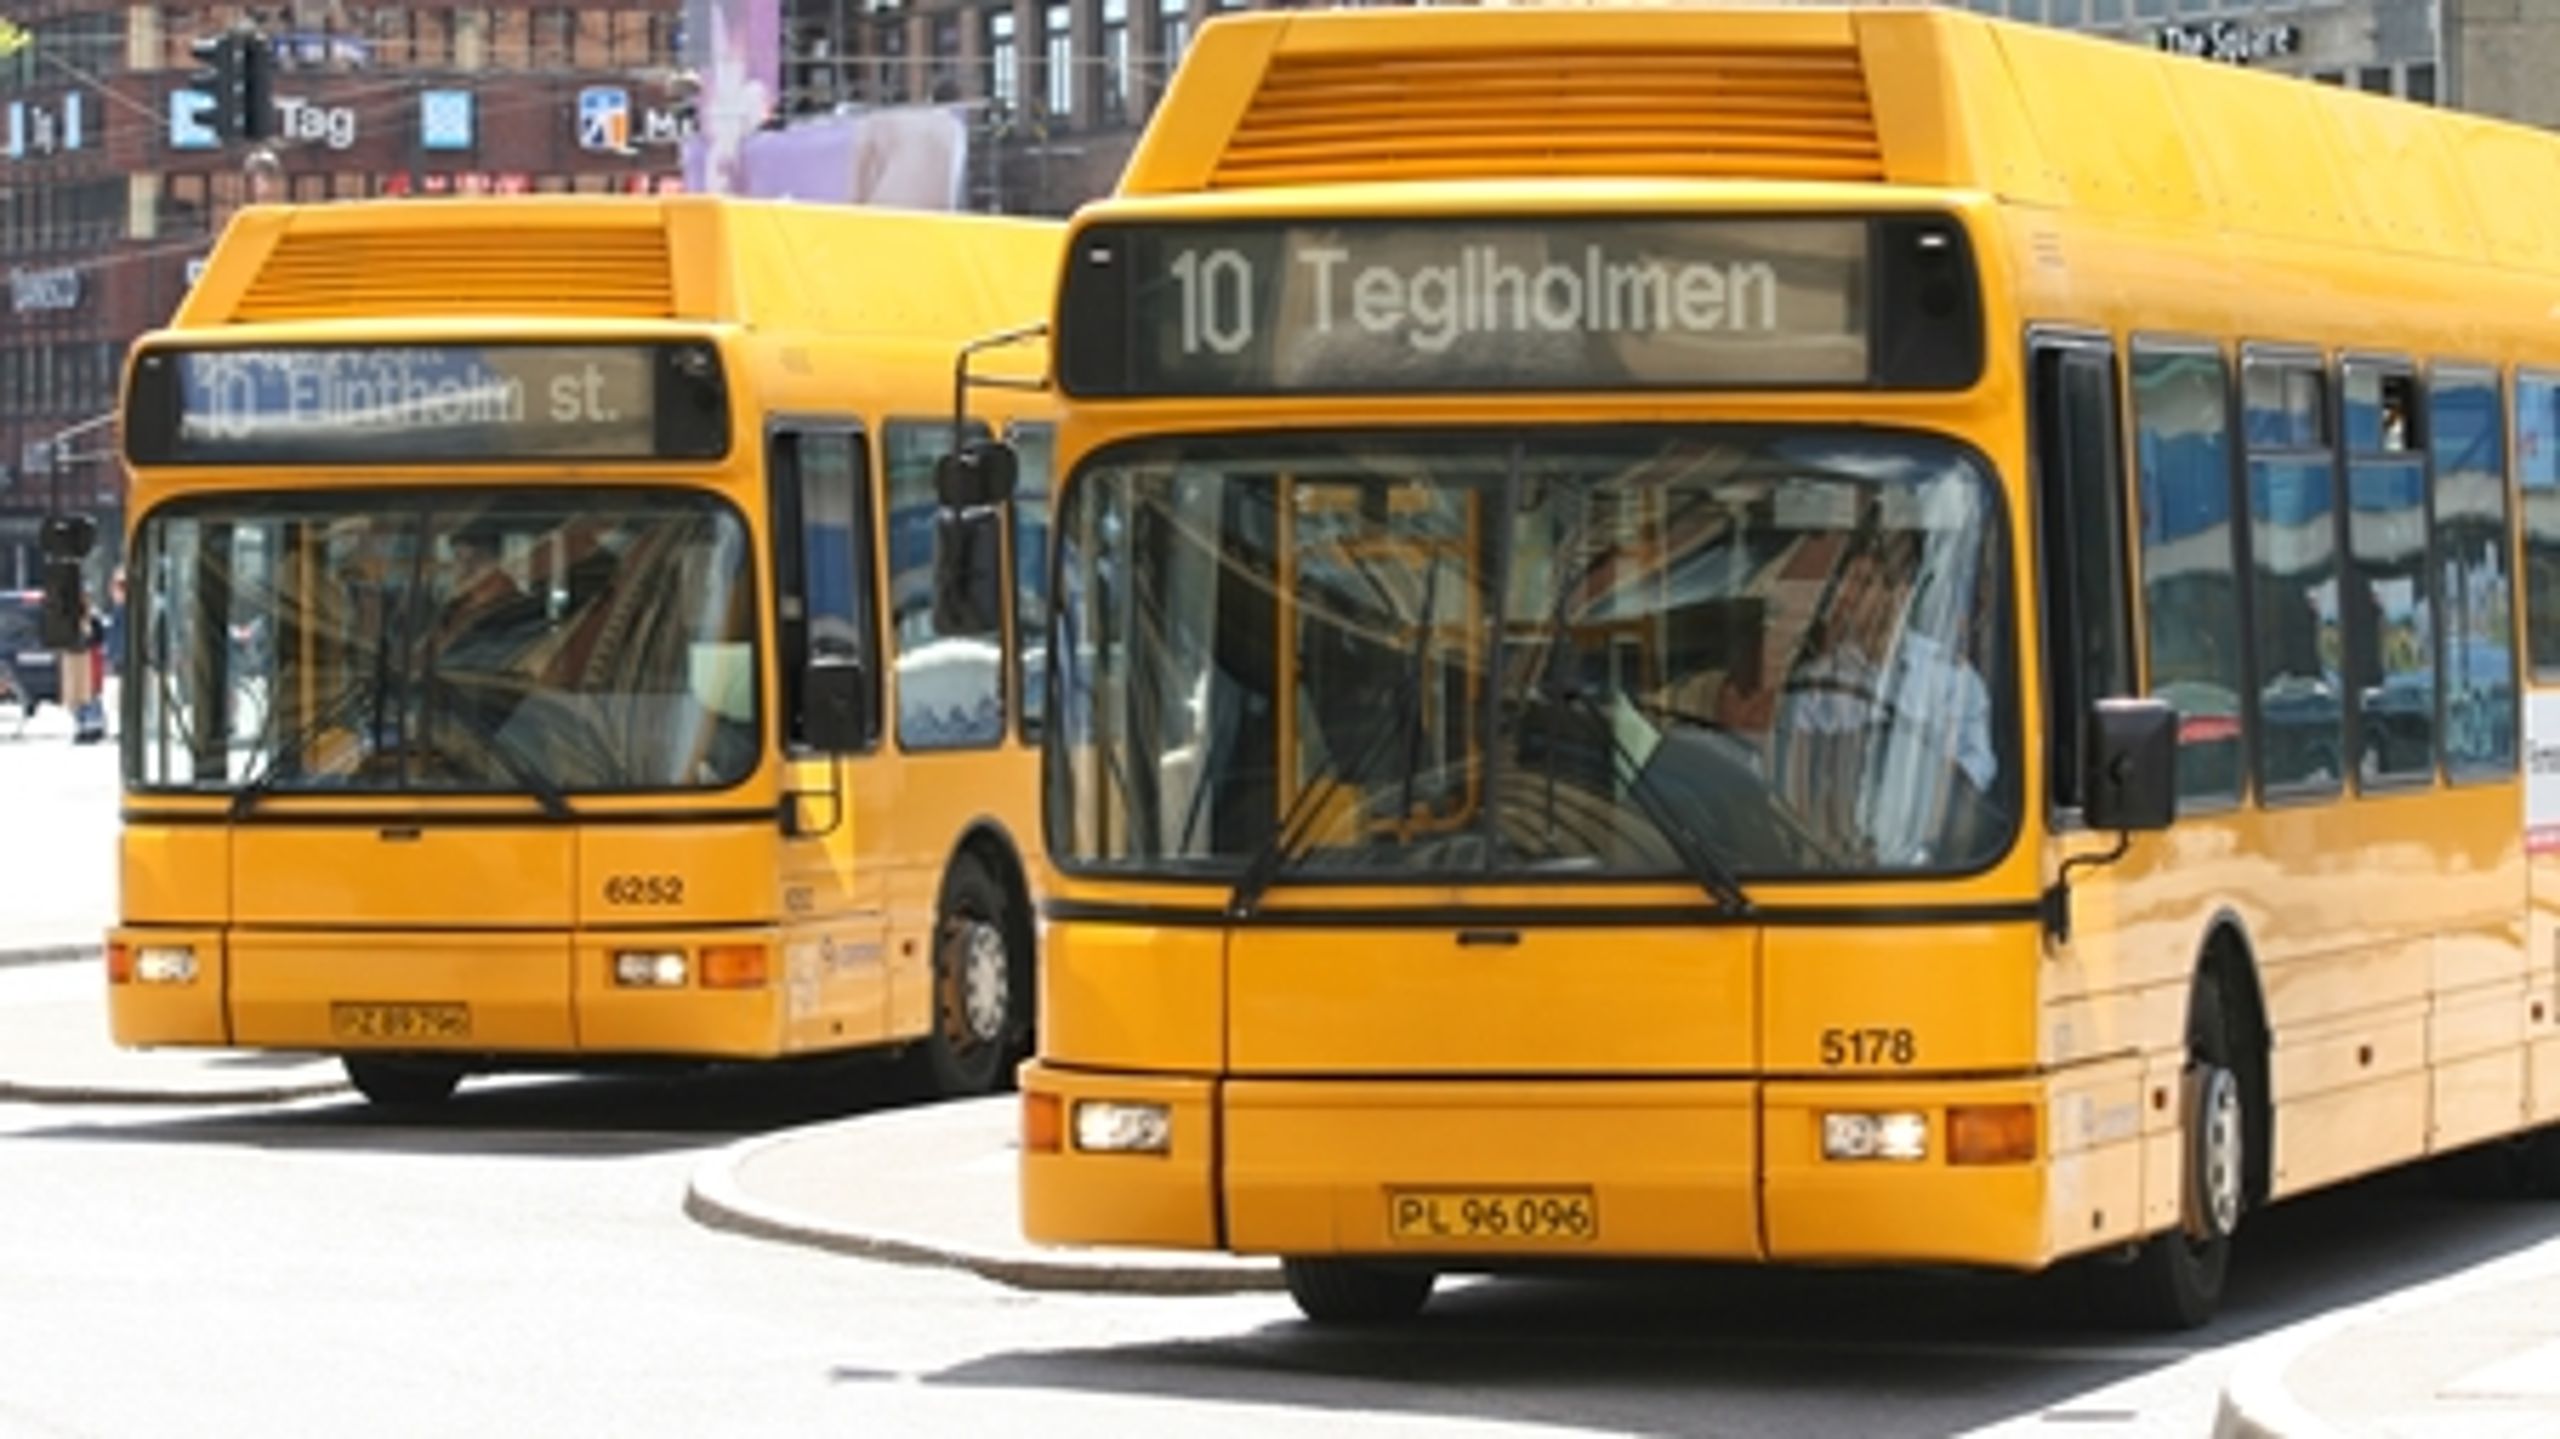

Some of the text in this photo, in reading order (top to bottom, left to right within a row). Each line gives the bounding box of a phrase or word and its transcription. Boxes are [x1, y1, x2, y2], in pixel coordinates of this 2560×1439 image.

[2165, 21, 2290, 63] The Square
[273, 96, 354, 148] Tag
[1170, 245, 1776, 353] 10 Teglholmen
[202, 363, 257, 439] 10
[551, 364, 619, 422] st.
[603, 875, 684, 905] 6252
[1821, 1029, 1916, 1065] 5178
[1399, 1200, 1589, 1234] PL 96 096
